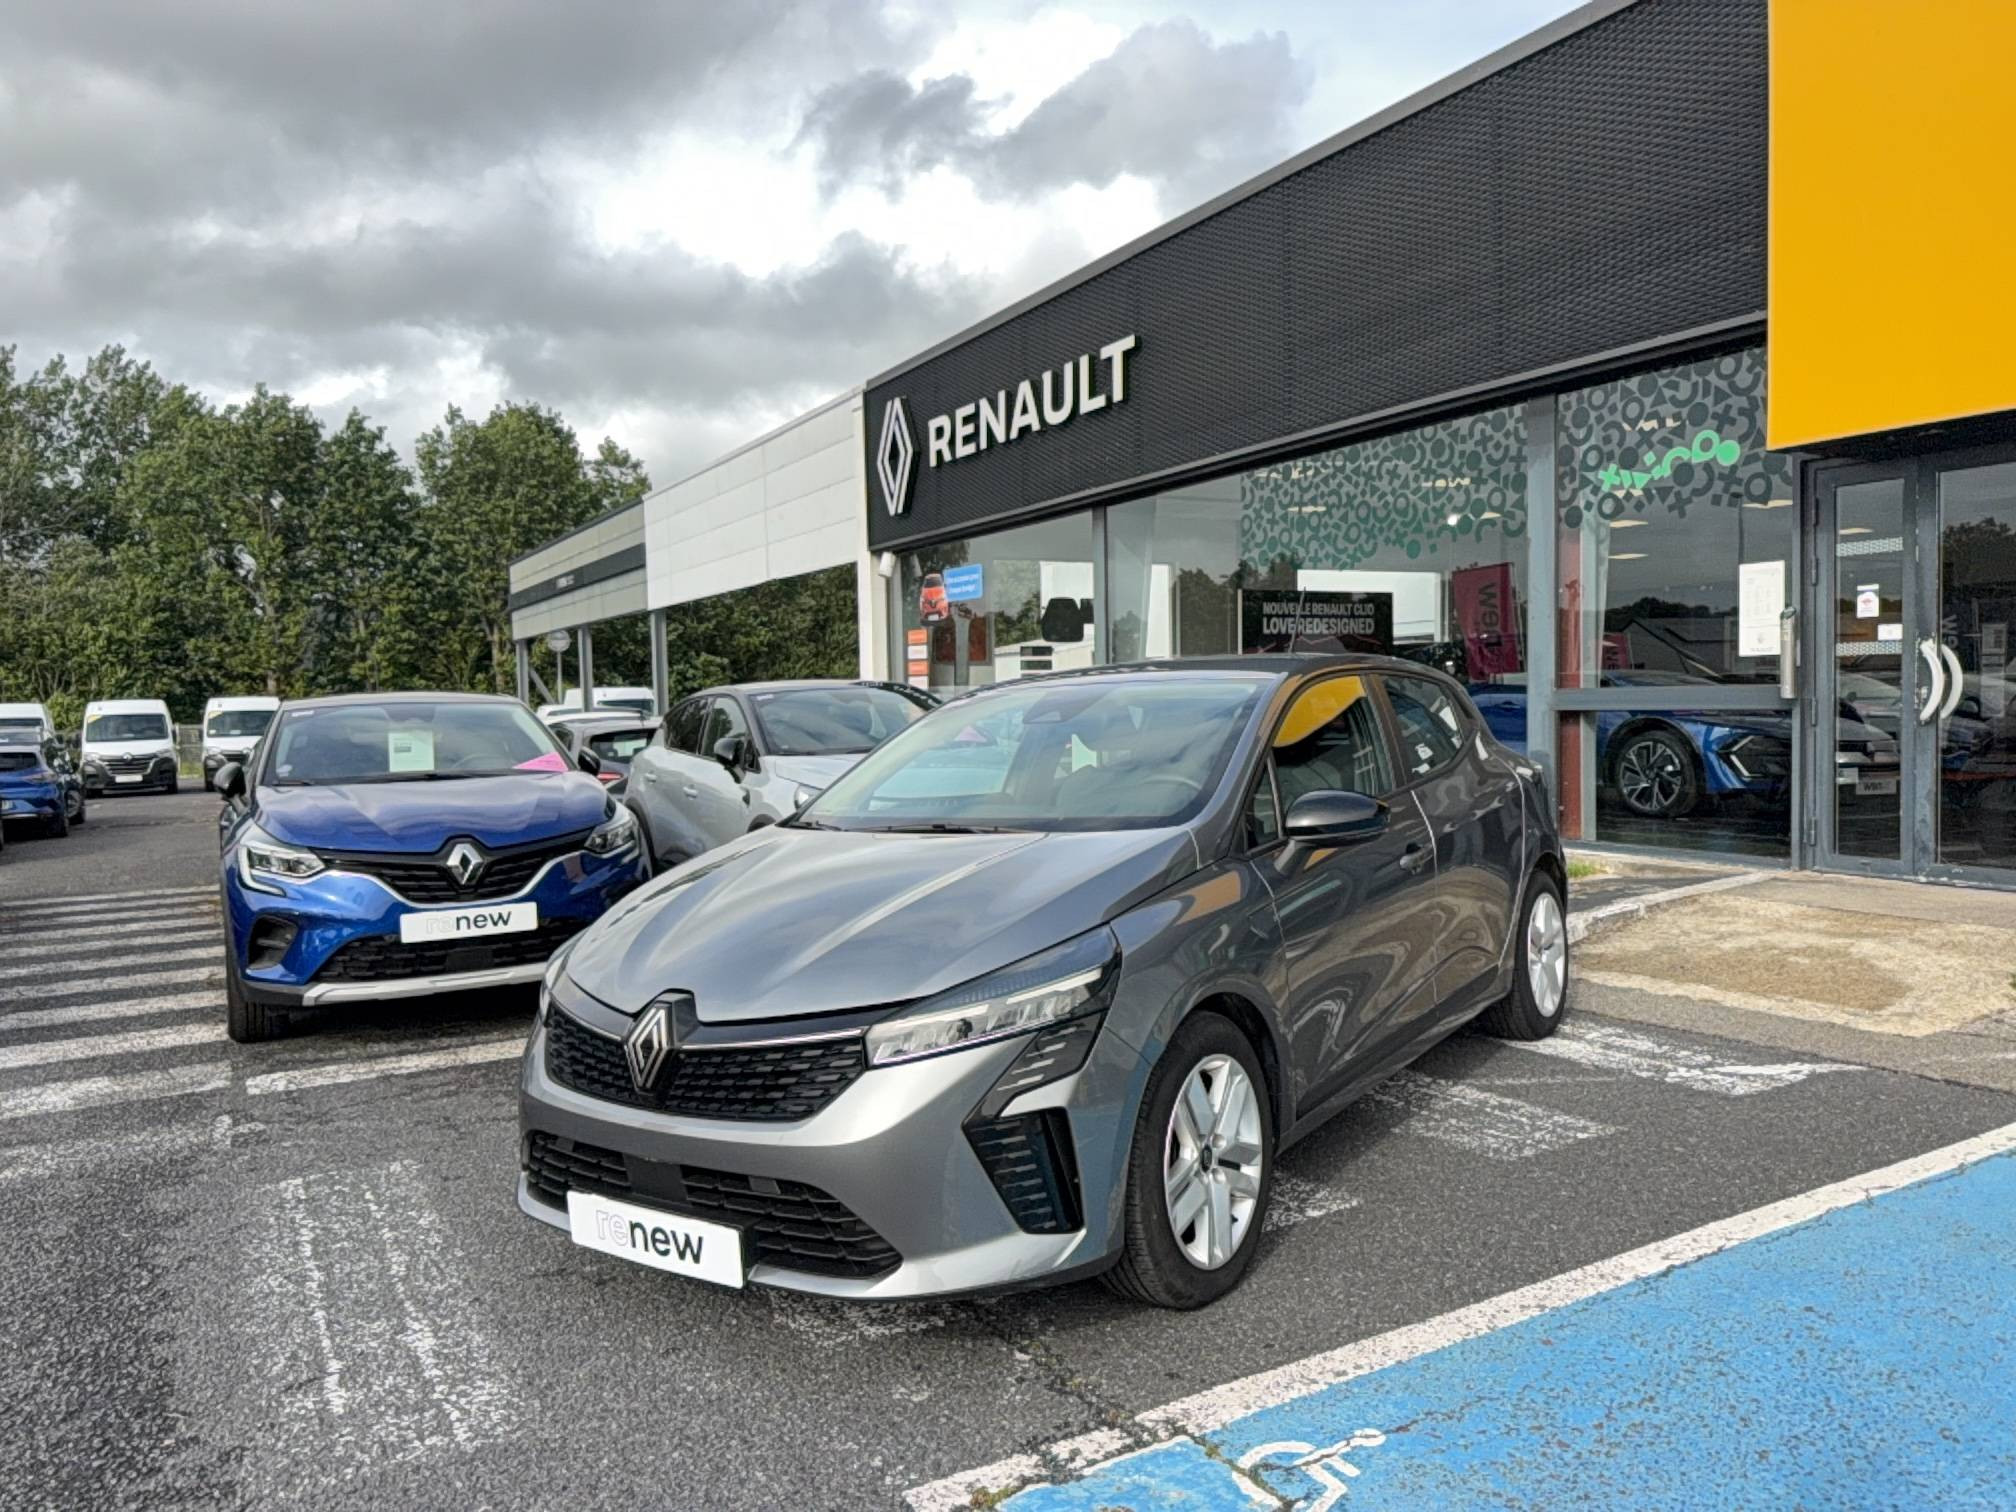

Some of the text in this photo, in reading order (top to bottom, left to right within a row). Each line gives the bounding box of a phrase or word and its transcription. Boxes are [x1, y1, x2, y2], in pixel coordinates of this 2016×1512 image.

[928, 334, 1136, 468] RENAULT
[1262, 602, 1375, 616] NOUVELLE RENAULT CLIO
[1262, 617, 1375, 635] LOVE REDESIGNED
[426, 911, 512, 934] renew
[595, 1210, 703, 1264] renew
